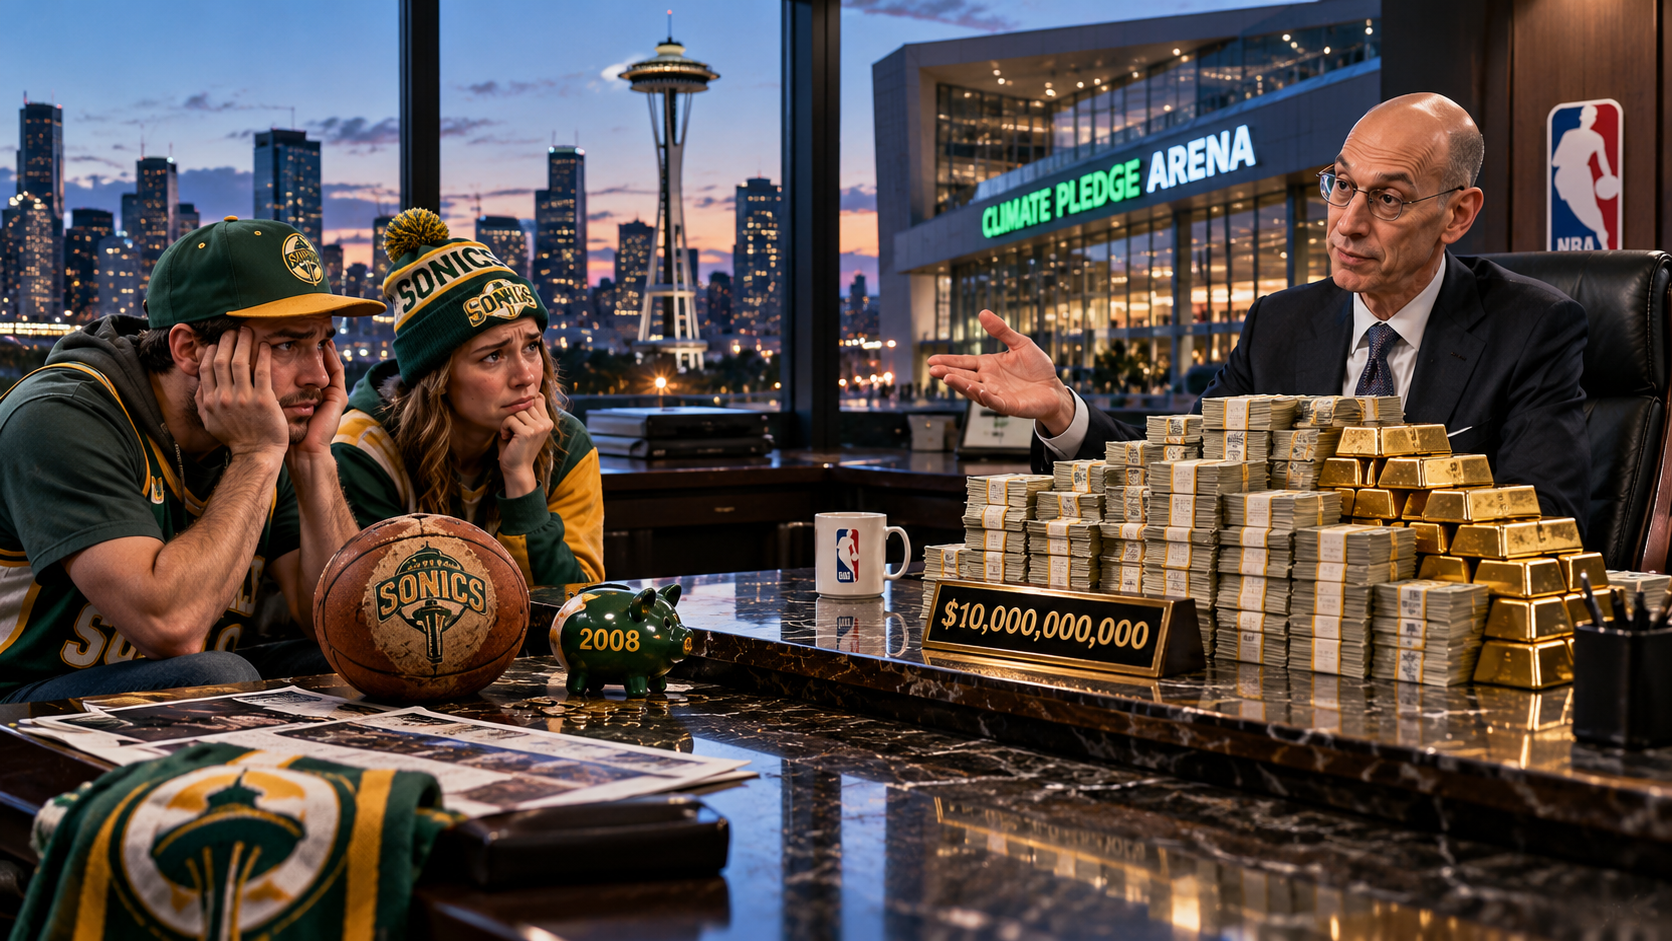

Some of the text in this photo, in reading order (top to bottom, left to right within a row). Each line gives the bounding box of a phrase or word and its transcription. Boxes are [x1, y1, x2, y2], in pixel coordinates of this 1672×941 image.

[982, 124, 1256, 238] CLIMATE PLEDGE ARENA
[380, 570, 485, 615] SONICS
[579, 628, 640, 652] 2008
[941, 598, 1149, 650] $10,000,000,000
